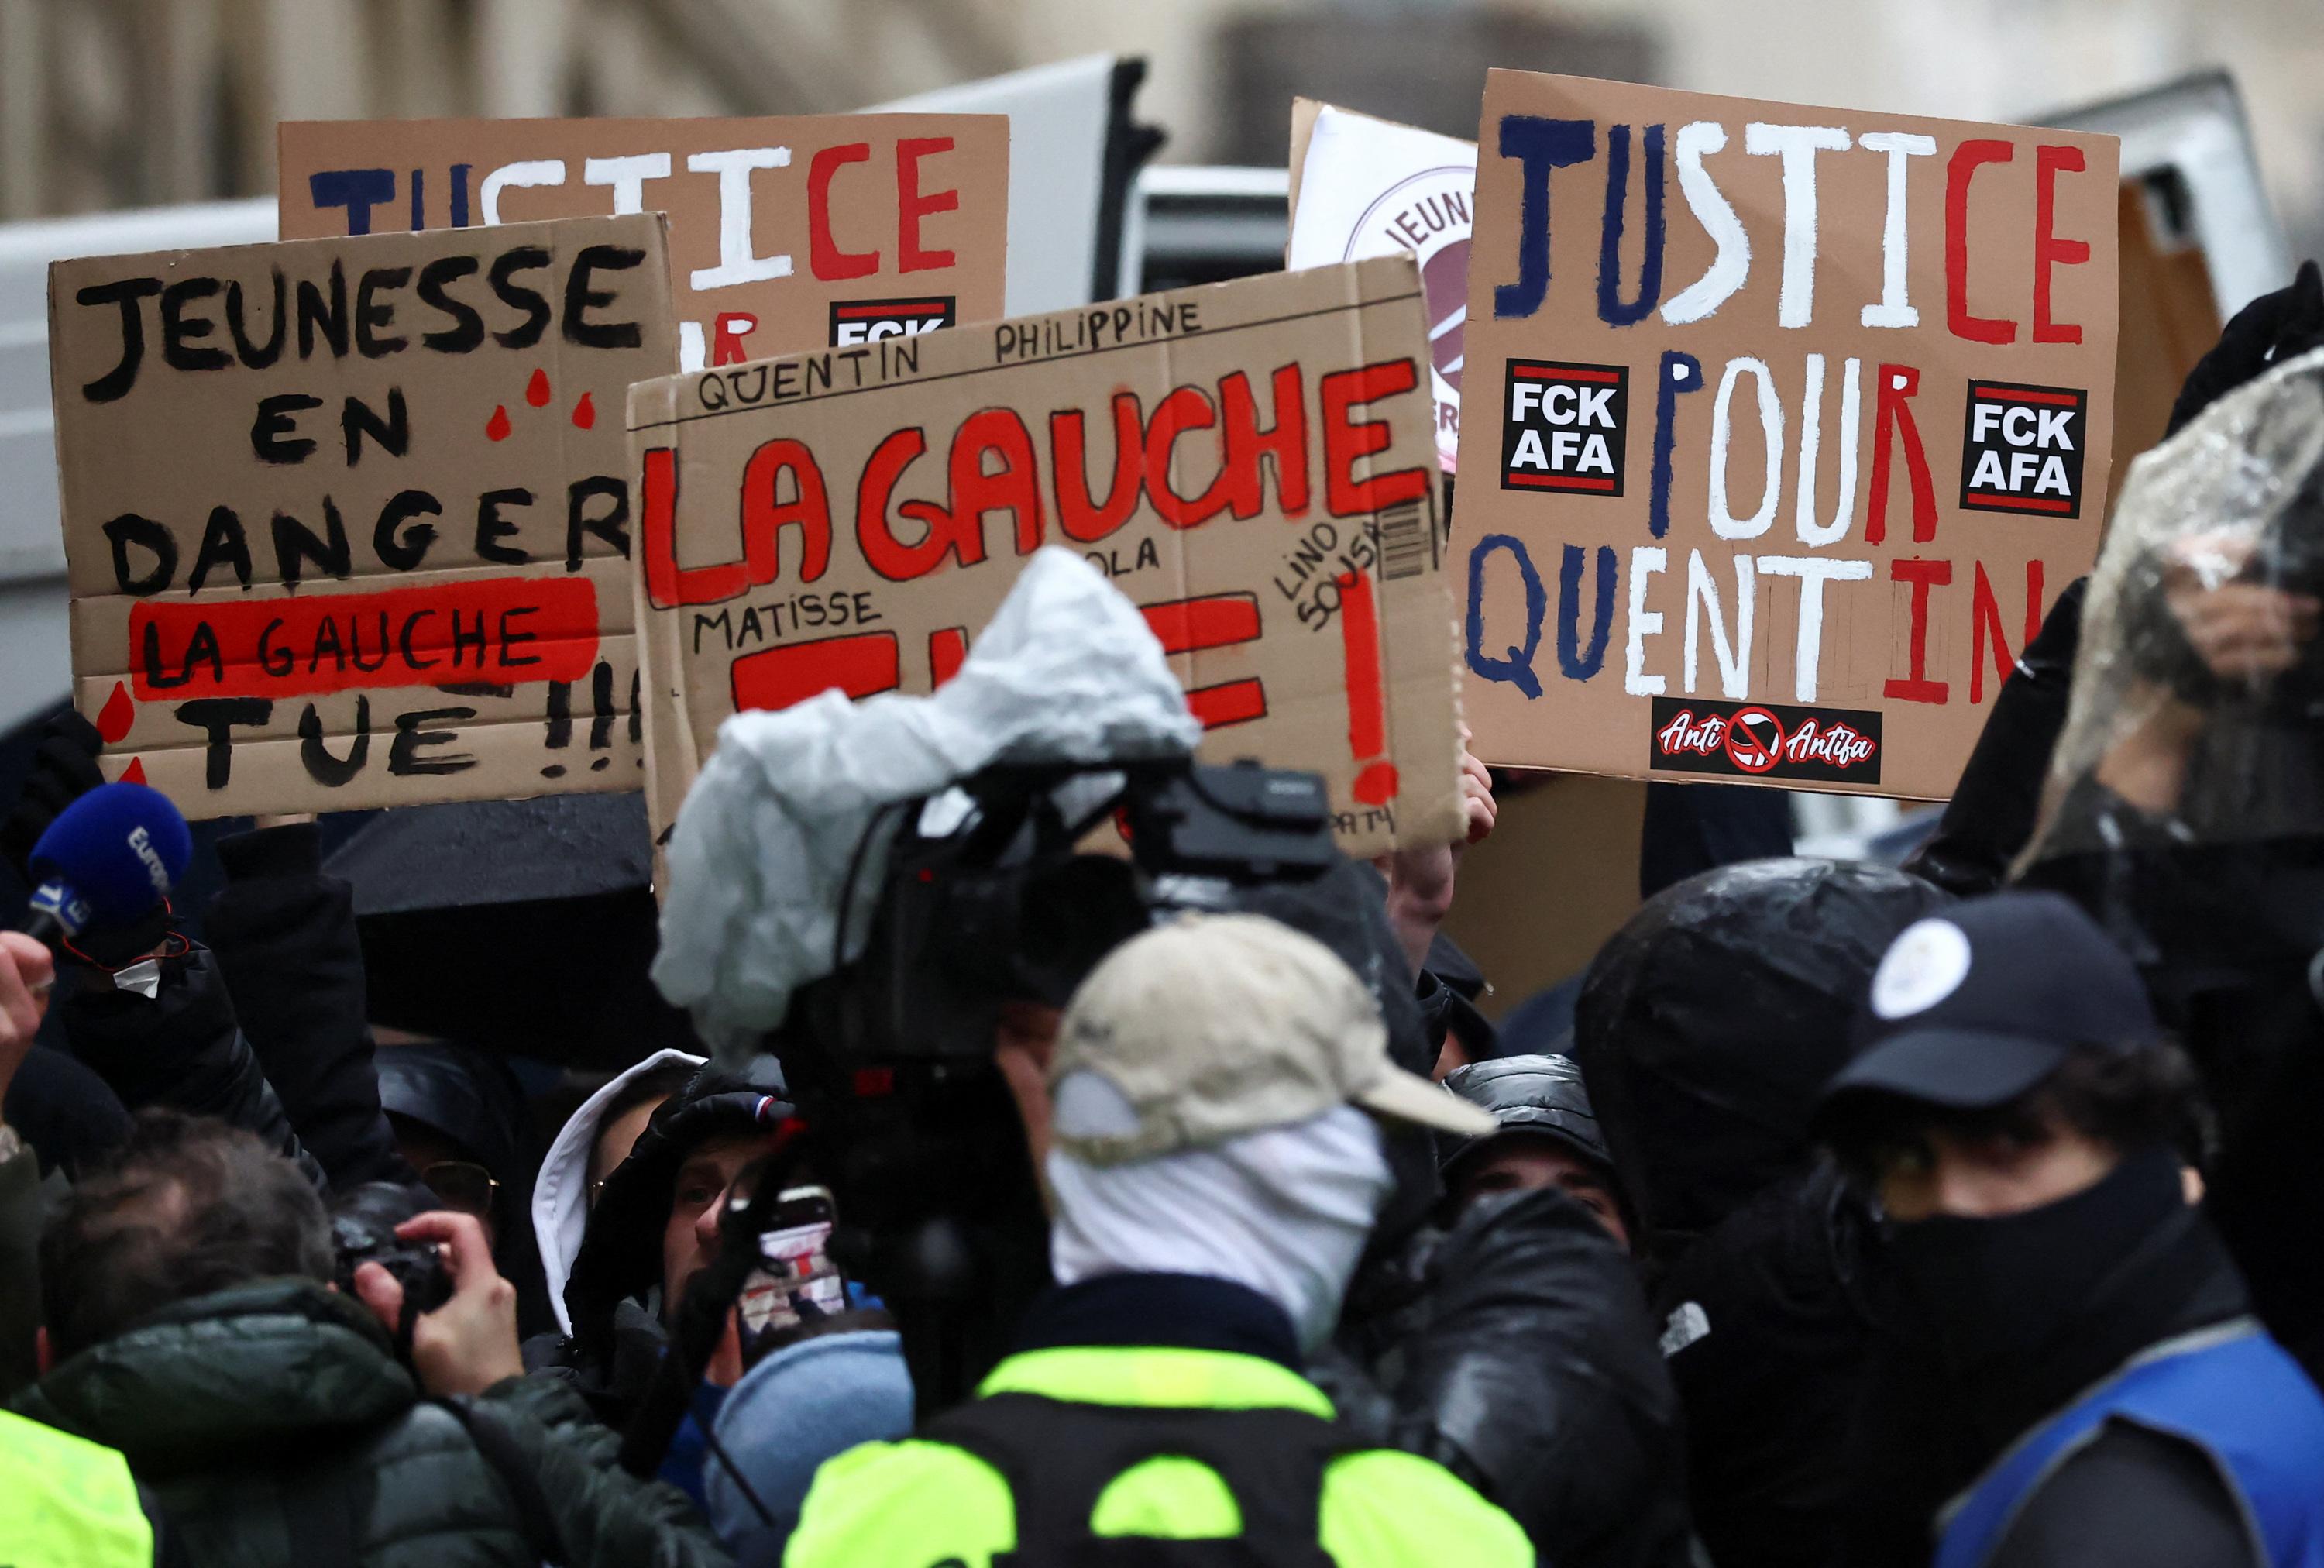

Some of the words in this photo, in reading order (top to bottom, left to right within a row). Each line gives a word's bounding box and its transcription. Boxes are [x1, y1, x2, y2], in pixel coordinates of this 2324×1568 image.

[1384, 191, 1473, 249] JEUN
[1494, 114, 2090, 345] JUSTICE
[76, 245, 647, 404] JEUNESSE
[698, 338, 920, 411] QUENTIN
[1511, 383, 1617, 428] FCK
[250, 387, 409, 466] EN
[1508, 432, 1615, 475] AFA
[1648, 350, 1940, 547] POUR
[1972, 404, 2076, 451] FCK
[642, 438, 832, 610] LA
[855, 358, 1432, 582] GAUCHE
[1968, 450, 2072, 497] AFA
[103, 475, 631, 597] DANGER
[1297, 521, 1387, 632] SOUSA
[143, 620, 225, 688] LA
[256, 605, 542, 676] GAUCHE
[1466, 534, 2044, 703] QUENTIN
[174, 694, 478, 789] TUE
[1659, 711, 1727, 754] Anti
[1786, 720, 1873, 765] Antifa
